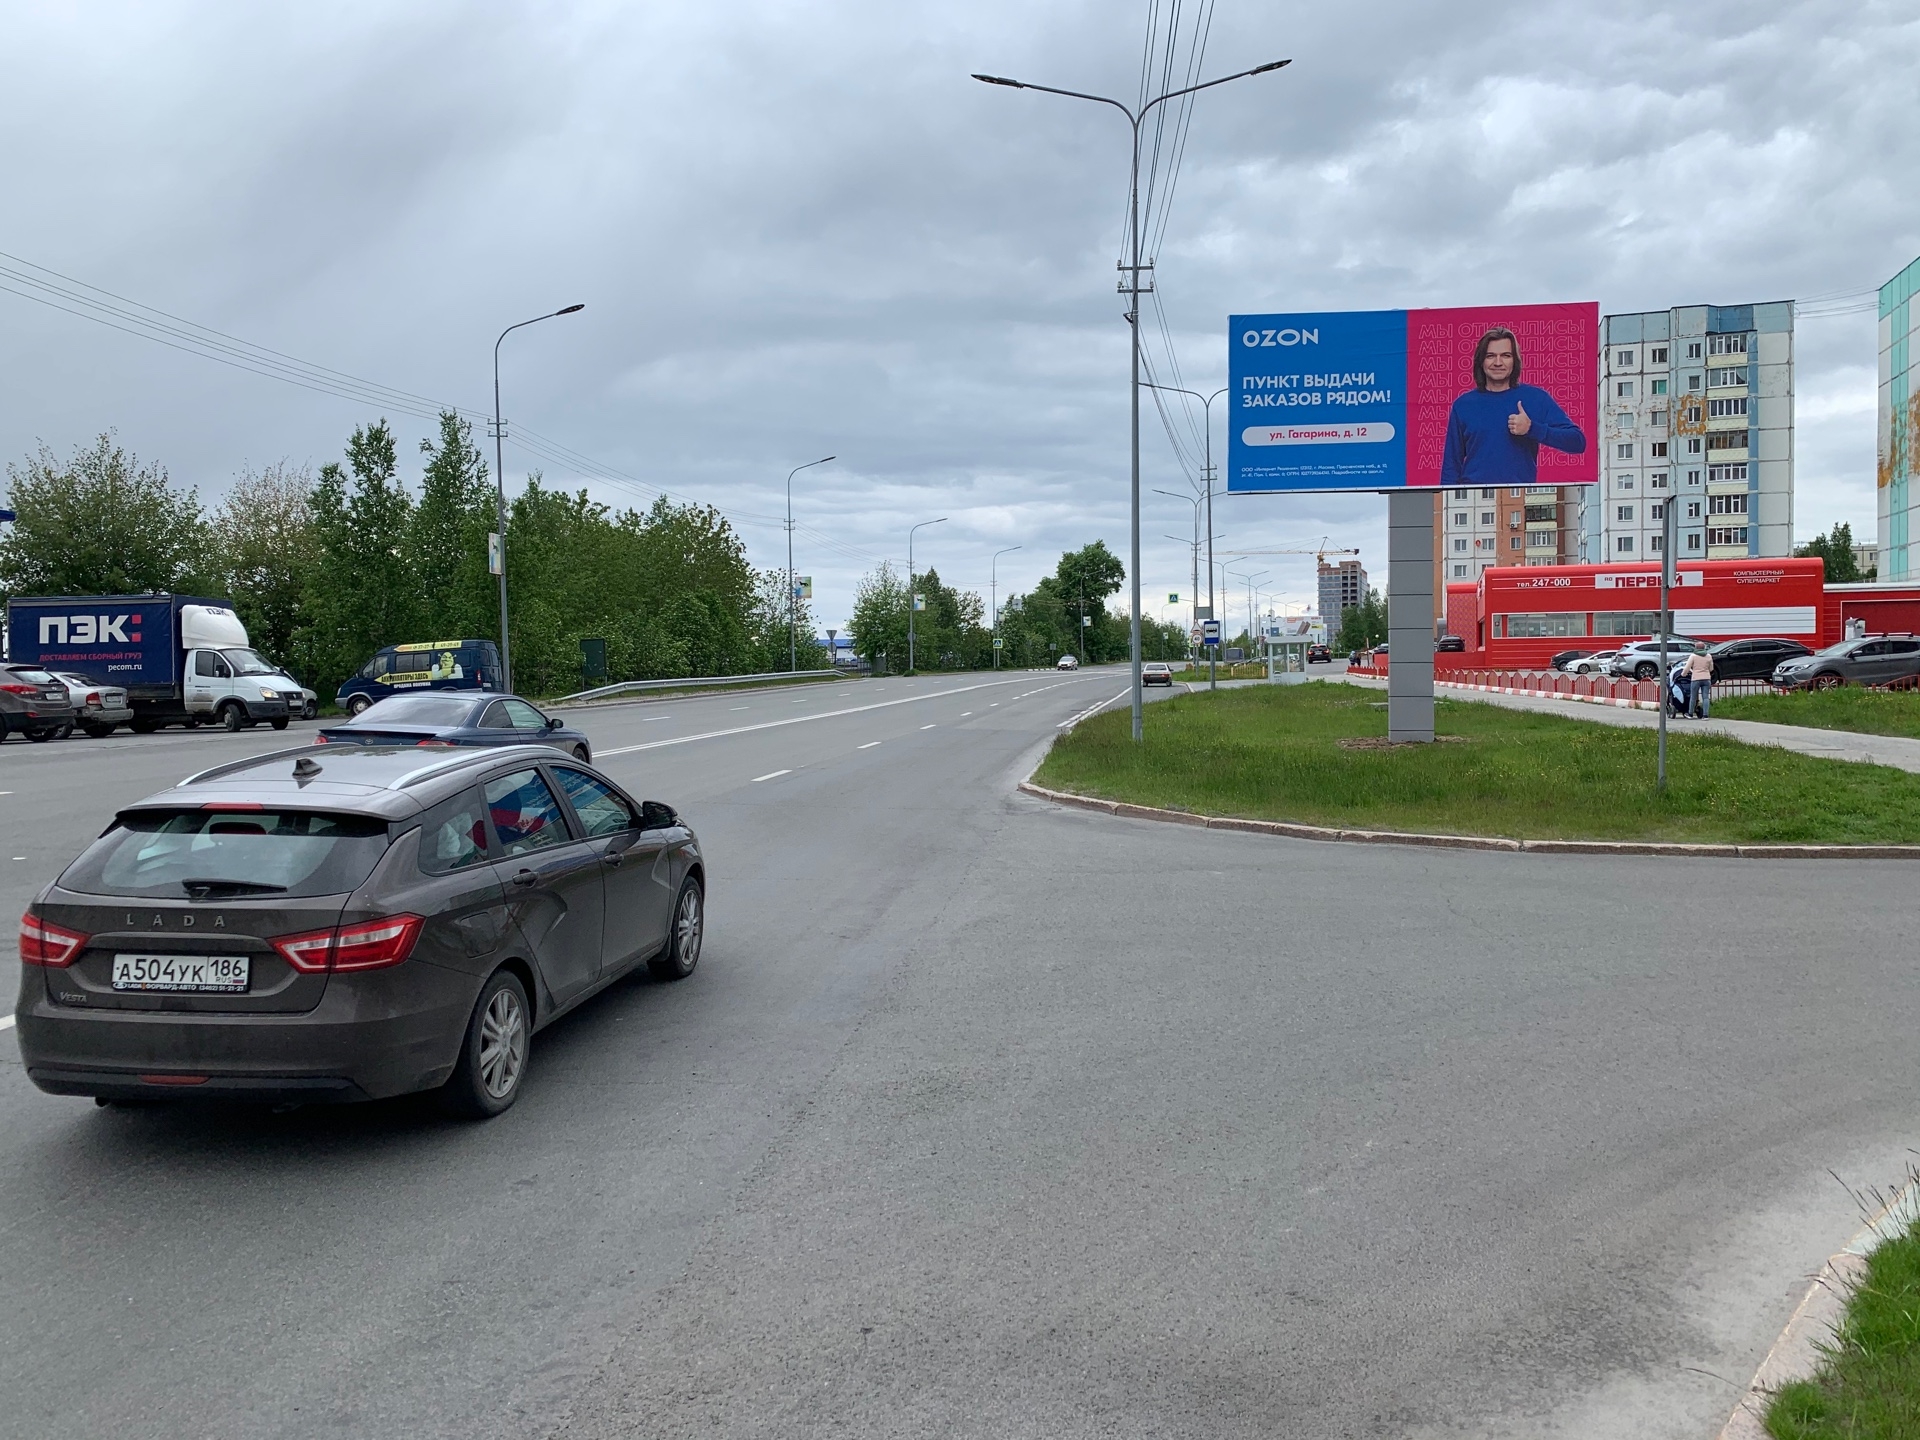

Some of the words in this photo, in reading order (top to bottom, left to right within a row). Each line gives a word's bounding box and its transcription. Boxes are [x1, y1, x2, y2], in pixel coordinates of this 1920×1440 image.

[1242, 328, 1319, 348] OZON
[1418, 323, 1453, 339] МЫ
[1418, 339, 1453, 355] МЫ
[1418, 356, 1453, 372] МЫ
[1242, 375, 1300, 390] ПУНКТ
[1303, 372, 1375, 388] ВЫДАЧИ
[1418, 372, 1453, 388] МЫ
[1242, 392, 1322, 408] ЗАКАЗОВ
[1327, 390, 1391, 406] РЯДОМ!
[1418, 388, 1453, 404] МЫ
[1269, 430, 1285, 441] ул.
[1288, 428, 1341, 440] Гагарина,
[1343, 429, 1354, 438] д.
[1356, 427, 1367, 437] 12
[1615, 573, 1683, 588] ПЕРВЙ
[1733, 569, 1785, 577] КОМПЬЮТЕРНЫЙ
[1532, 577, 1571, 587] 247-000
[38, 653, 87, 662] ДОСТАВЛЯЕМ
[88, 651, 123, 660] СБОРНЫЙ
[124, 652, 142, 660] ГРУЗ
[108, 663, 142, 672] pecom.ru
[126, 914, 226, 927] LADA
[118, 958, 205, 982] А504УК
[210, 959, 242, 977] 186
